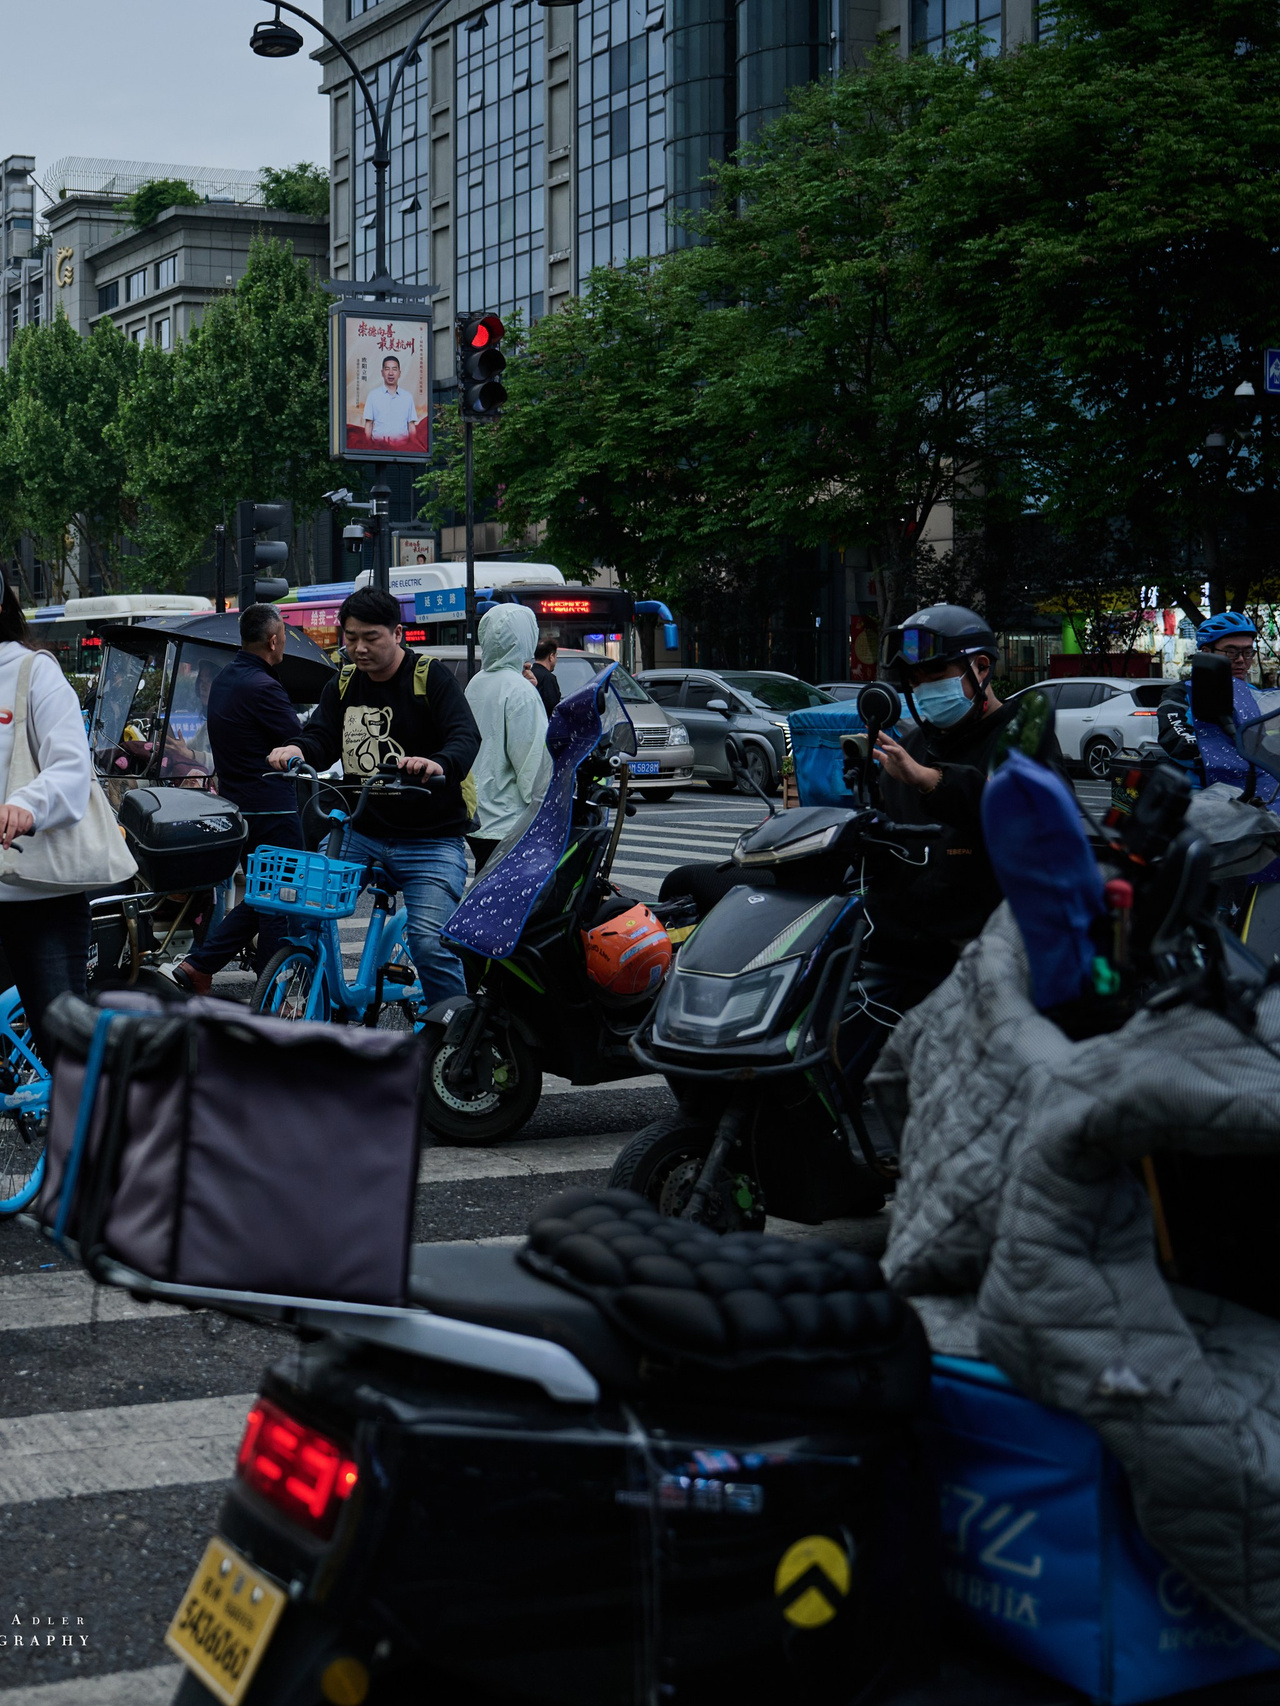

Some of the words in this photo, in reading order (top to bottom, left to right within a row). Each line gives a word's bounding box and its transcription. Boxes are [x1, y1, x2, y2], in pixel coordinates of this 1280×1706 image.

[358, 321, 395, 338] 崇德向善
[377, 337, 415, 355] 最美杭州
[399, 578, 422, 587] ELECTRIC
[424, 593, 456, 607] 延安路
